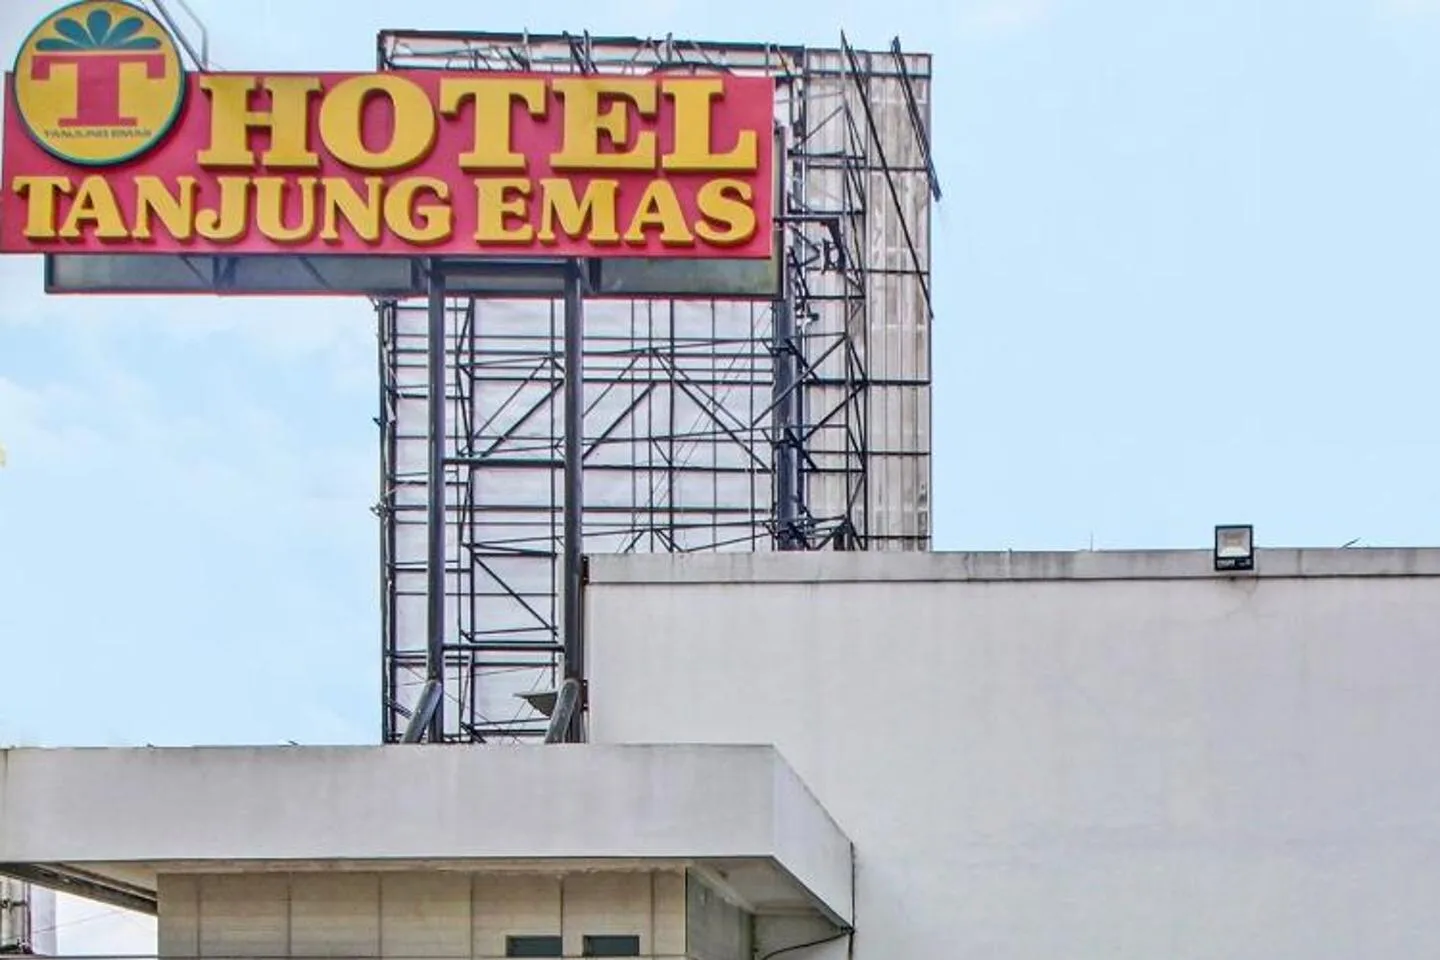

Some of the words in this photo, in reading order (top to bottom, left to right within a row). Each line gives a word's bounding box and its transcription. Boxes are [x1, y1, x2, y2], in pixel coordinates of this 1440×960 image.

[31, 54, 165, 127] T
[198, 77, 758, 171] HOTEL
[12, 175, 453, 244] TANJUNG
[473, 177, 757, 246] EMAS
